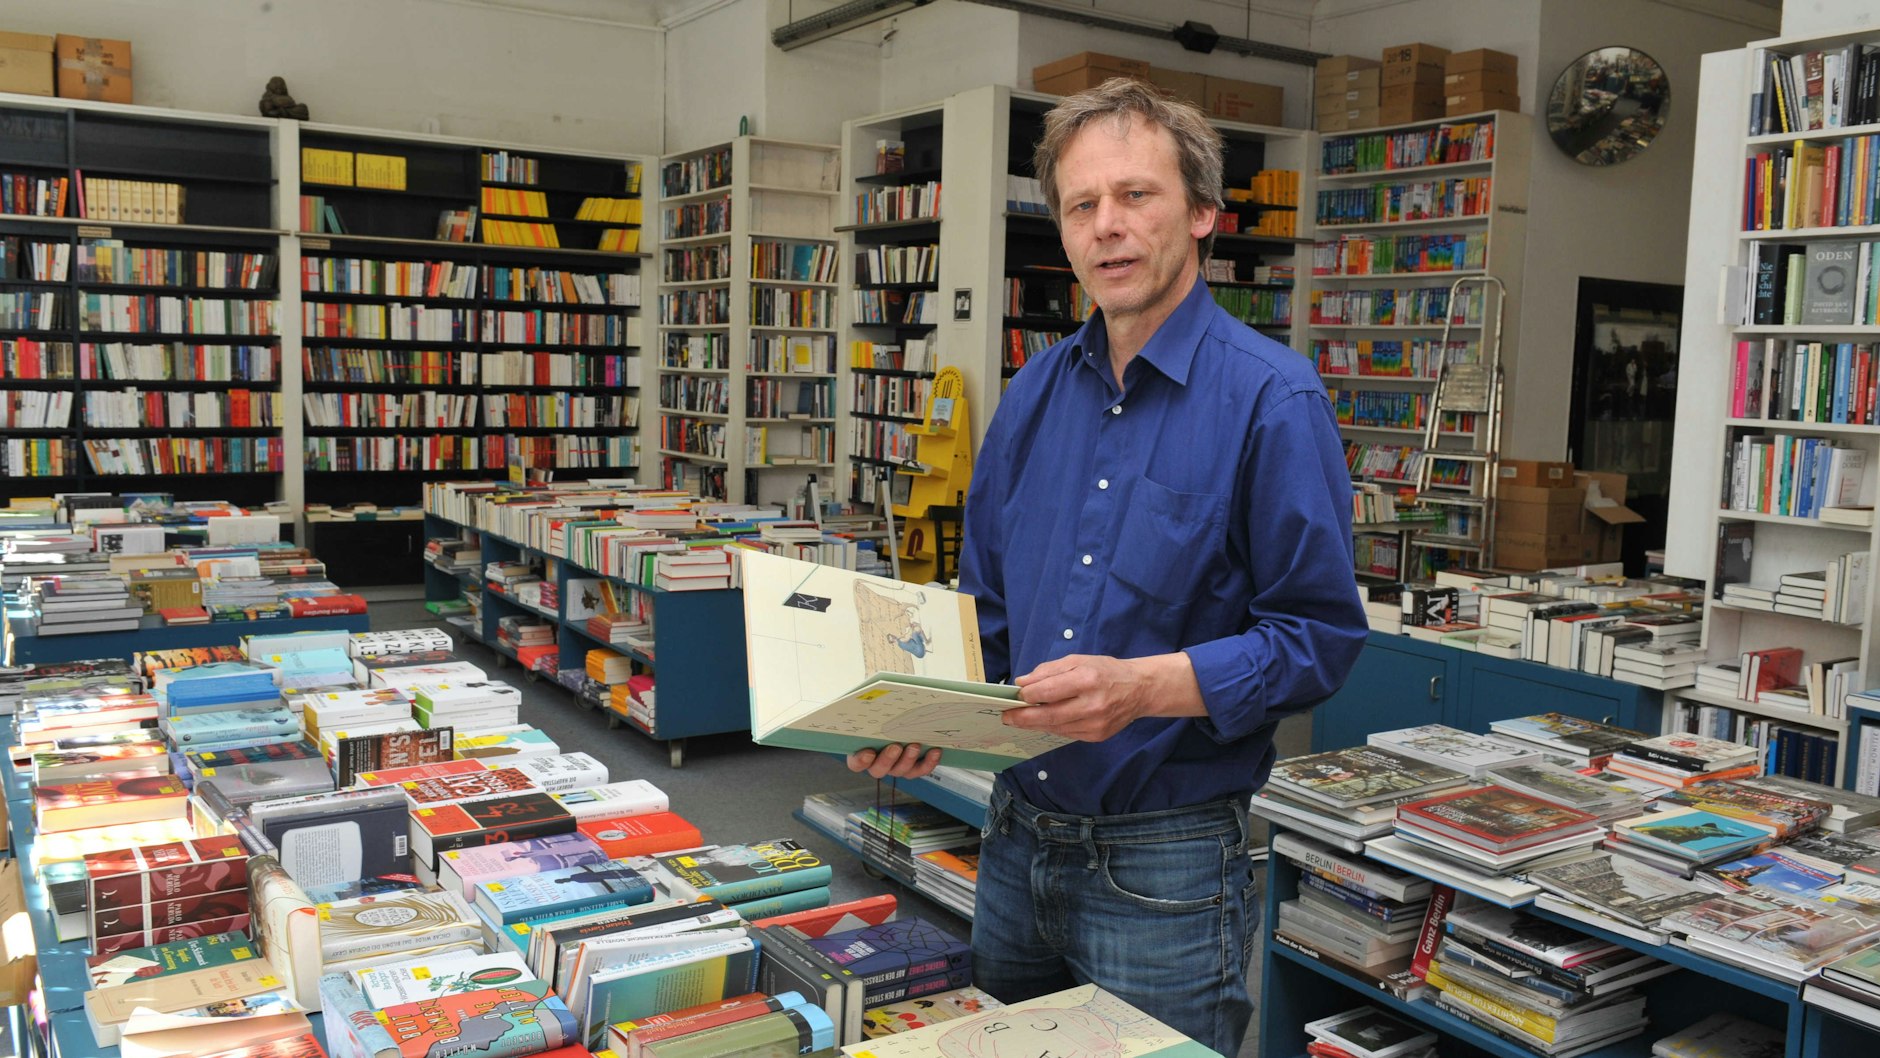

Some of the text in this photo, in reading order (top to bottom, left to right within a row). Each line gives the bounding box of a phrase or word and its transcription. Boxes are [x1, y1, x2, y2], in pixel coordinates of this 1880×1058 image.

[1816, 250, 1853, 262] ODEN
[797, 592, 817, 611] K
[1305, 852, 1367, 884] BERLIN BERLIN
[166, 874, 175, 896] NERUDA
[173, 874, 182, 893] PABLO
[580, 902, 605, 912] ALLENDE
[607, 899, 625, 908] ISABEL
[1751, 888, 1878, 930] BERLIN
[168, 902, 176, 926] NERUDA
[175, 903, 183, 922] PABLO
[579, 919, 634, 934] Tristan Garcia
[1421, 894, 1445, 955] Ganz Berlin
[415, 935, 434, 944] WILDE
[435, 932, 450, 941] OSCAR
[1275, 934, 1289, 945] Palast
[1289, 941, 1298, 949] der
[331, 947, 347, 958] GRAY
[348, 944, 368, 955] DORIAN
[863, 975, 884, 986] STRASS
[883, 971, 895, 981] DEN
[895, 969, 906, 979] AUF
[864, 994, 884, 1006] STRASS
[883, 991, 895, 1001] DEN
[895, 989, 906, 999] AUF
[1450, 1007, 1470, 1022] BERLIN
[1468, 996, 1525, 1026] ARCHITEKTUR
[391, 1013, 423, 1039] BRIT
[984, 1021, 1011, 1034] B
[1031, 1018, 1058, 1032] C
[501, 1032, 543, 1046] BENNETT
[435, 1043, 477, 1058] MÜTTER
